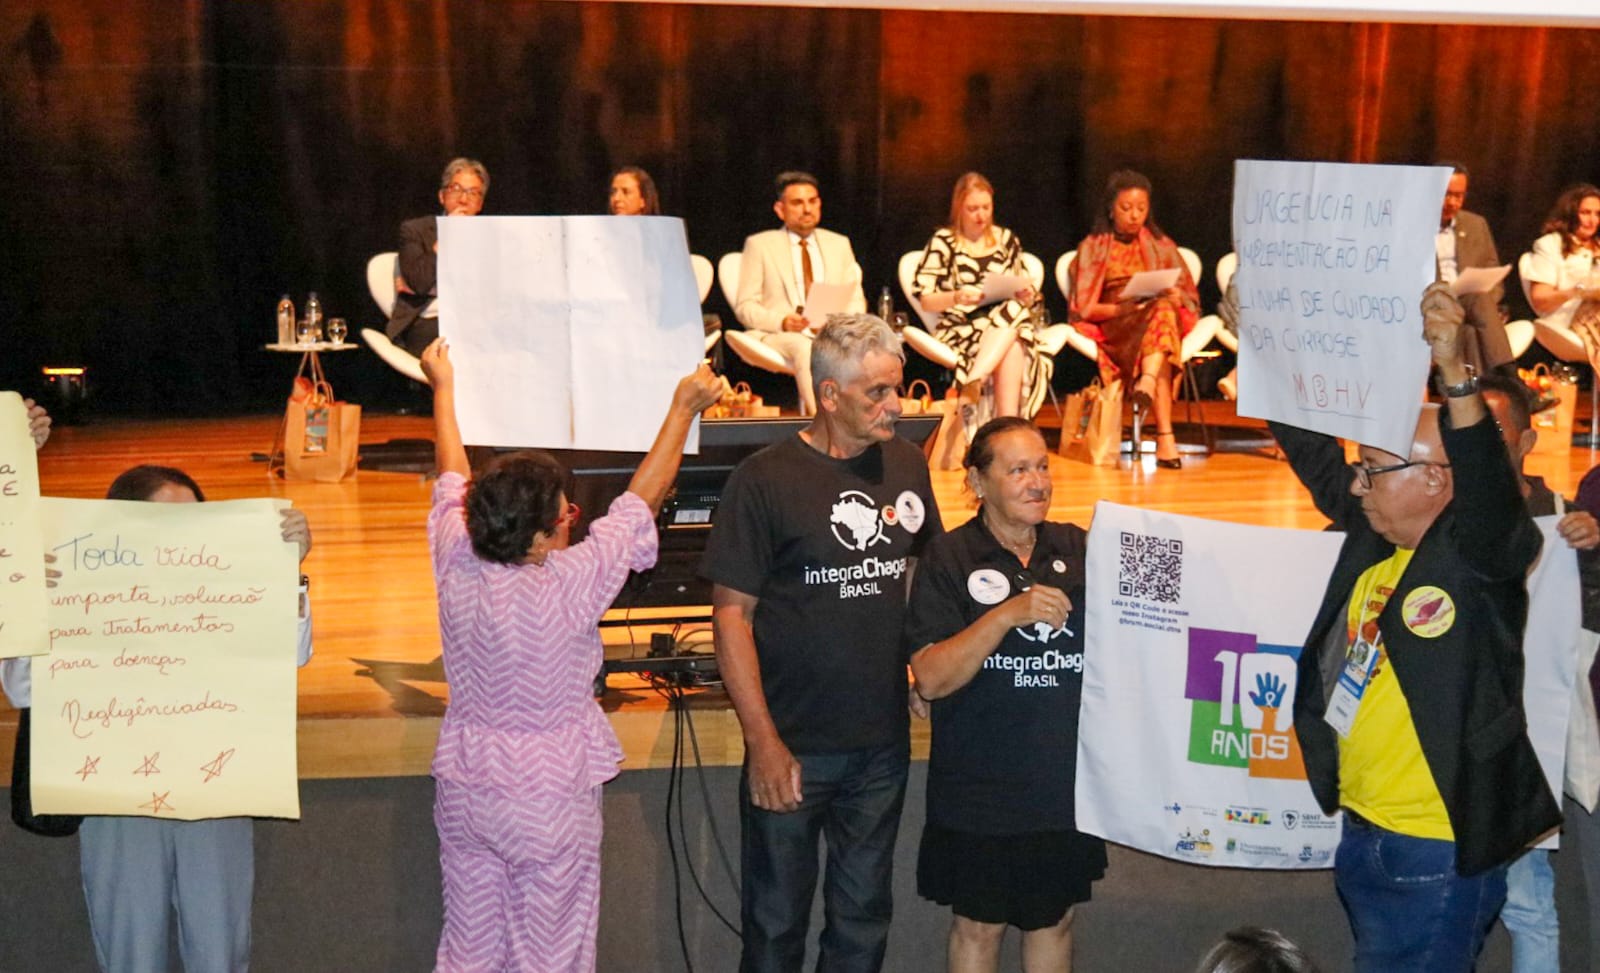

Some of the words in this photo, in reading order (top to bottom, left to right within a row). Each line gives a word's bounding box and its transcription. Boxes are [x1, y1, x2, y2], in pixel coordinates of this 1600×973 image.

[1363, 199, 1392, 229] NA
[1364, 244, 1390, 273] DA
[1300, 289, 1325, 318] DE
[1332, 289, 1407, 324] CUIDADO
[1249, 324, 1276, 352] DA
[52, 532, 144, 572] Toda
[805, 556, 906, 587] integraChaga
[839, 582, 882, 599] BRASIL
[49, 625, 92, 651] para
[48, 657, 99, 680] para
[983, 649, 1084, 675] ntegraChag
[1014, 674, 1059, 687] BRASIL
[1211, 729, 1289, 760] ANOS
